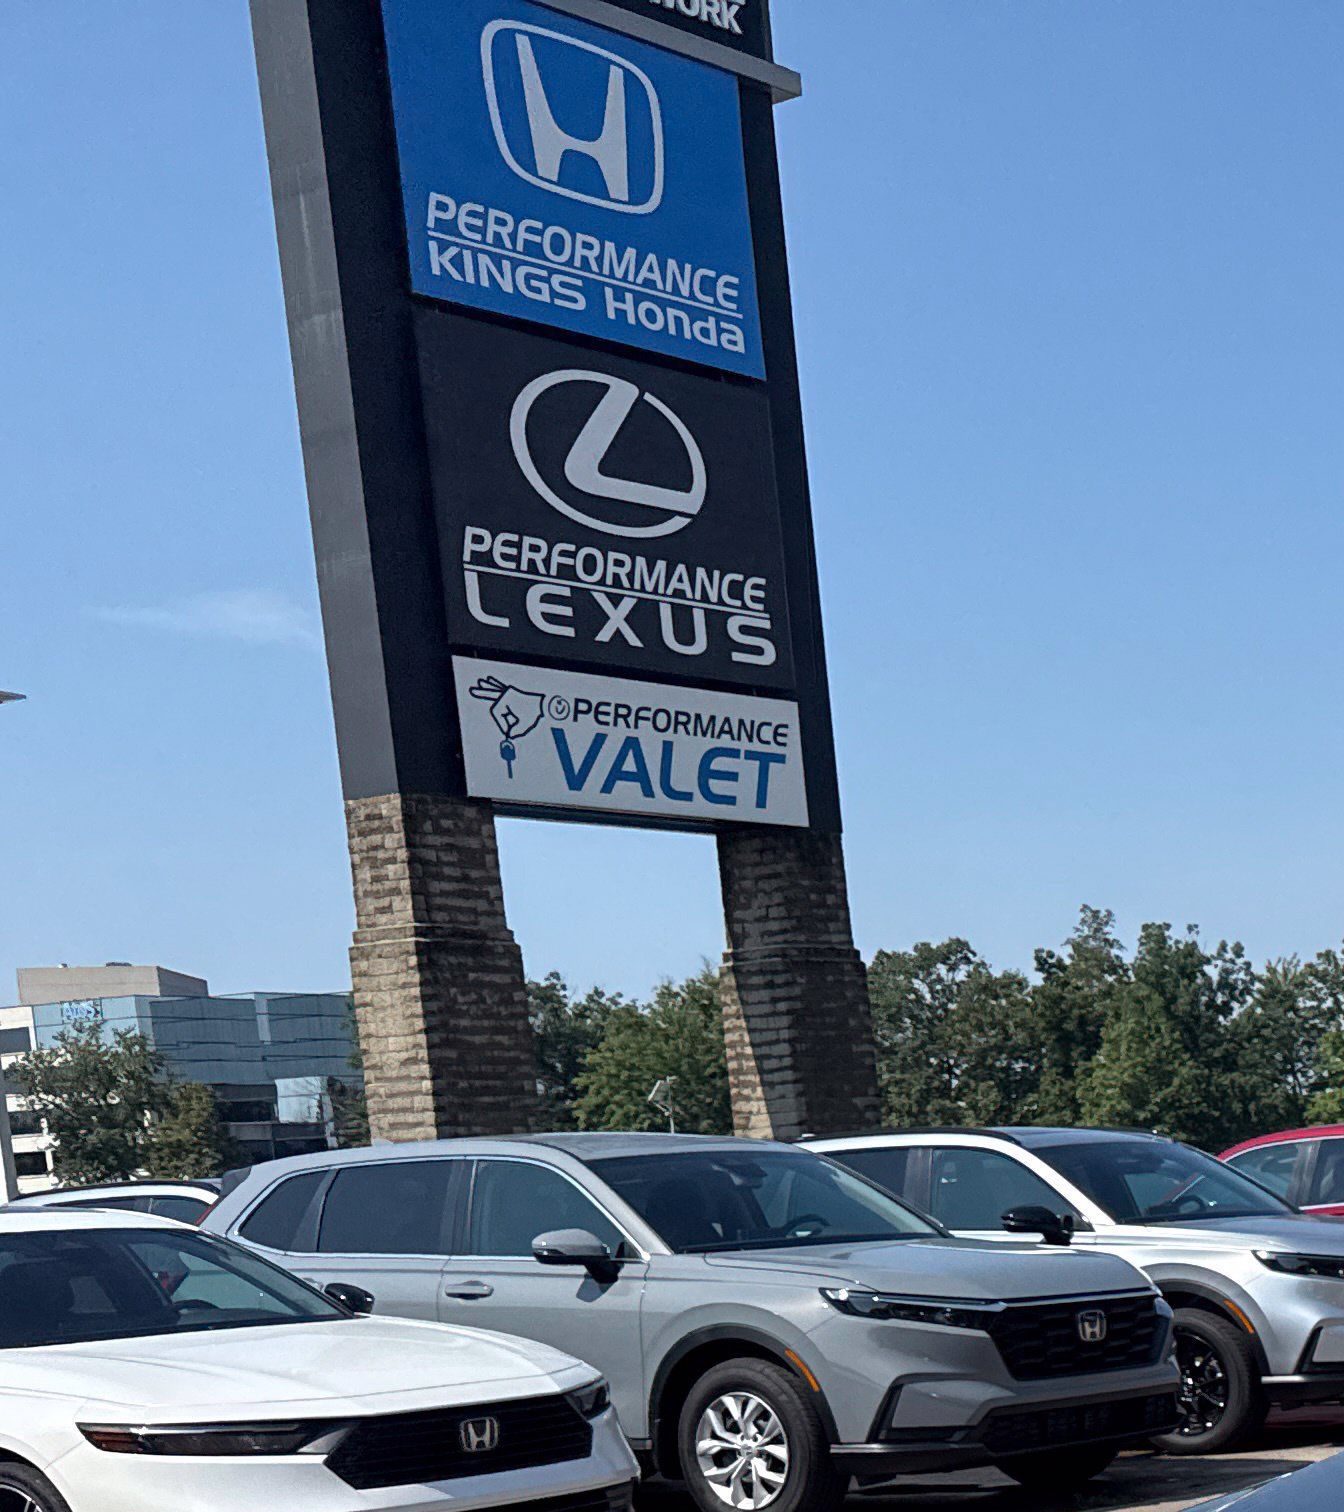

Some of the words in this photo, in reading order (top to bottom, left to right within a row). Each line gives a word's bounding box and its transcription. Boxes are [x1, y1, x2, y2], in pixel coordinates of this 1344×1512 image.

[426, 191, 741, 311] PERFORMANCE
[428, 240, 587, 311] KINGS
[604, 286, 746, 354] Honda
[462, 525, 767, 612] PERFORMANCE
[463, 570, 778, 667] LEXUS
[550, 726, 787, 809] VALET
[572, 697, 789, 748] PERFORMANCE
